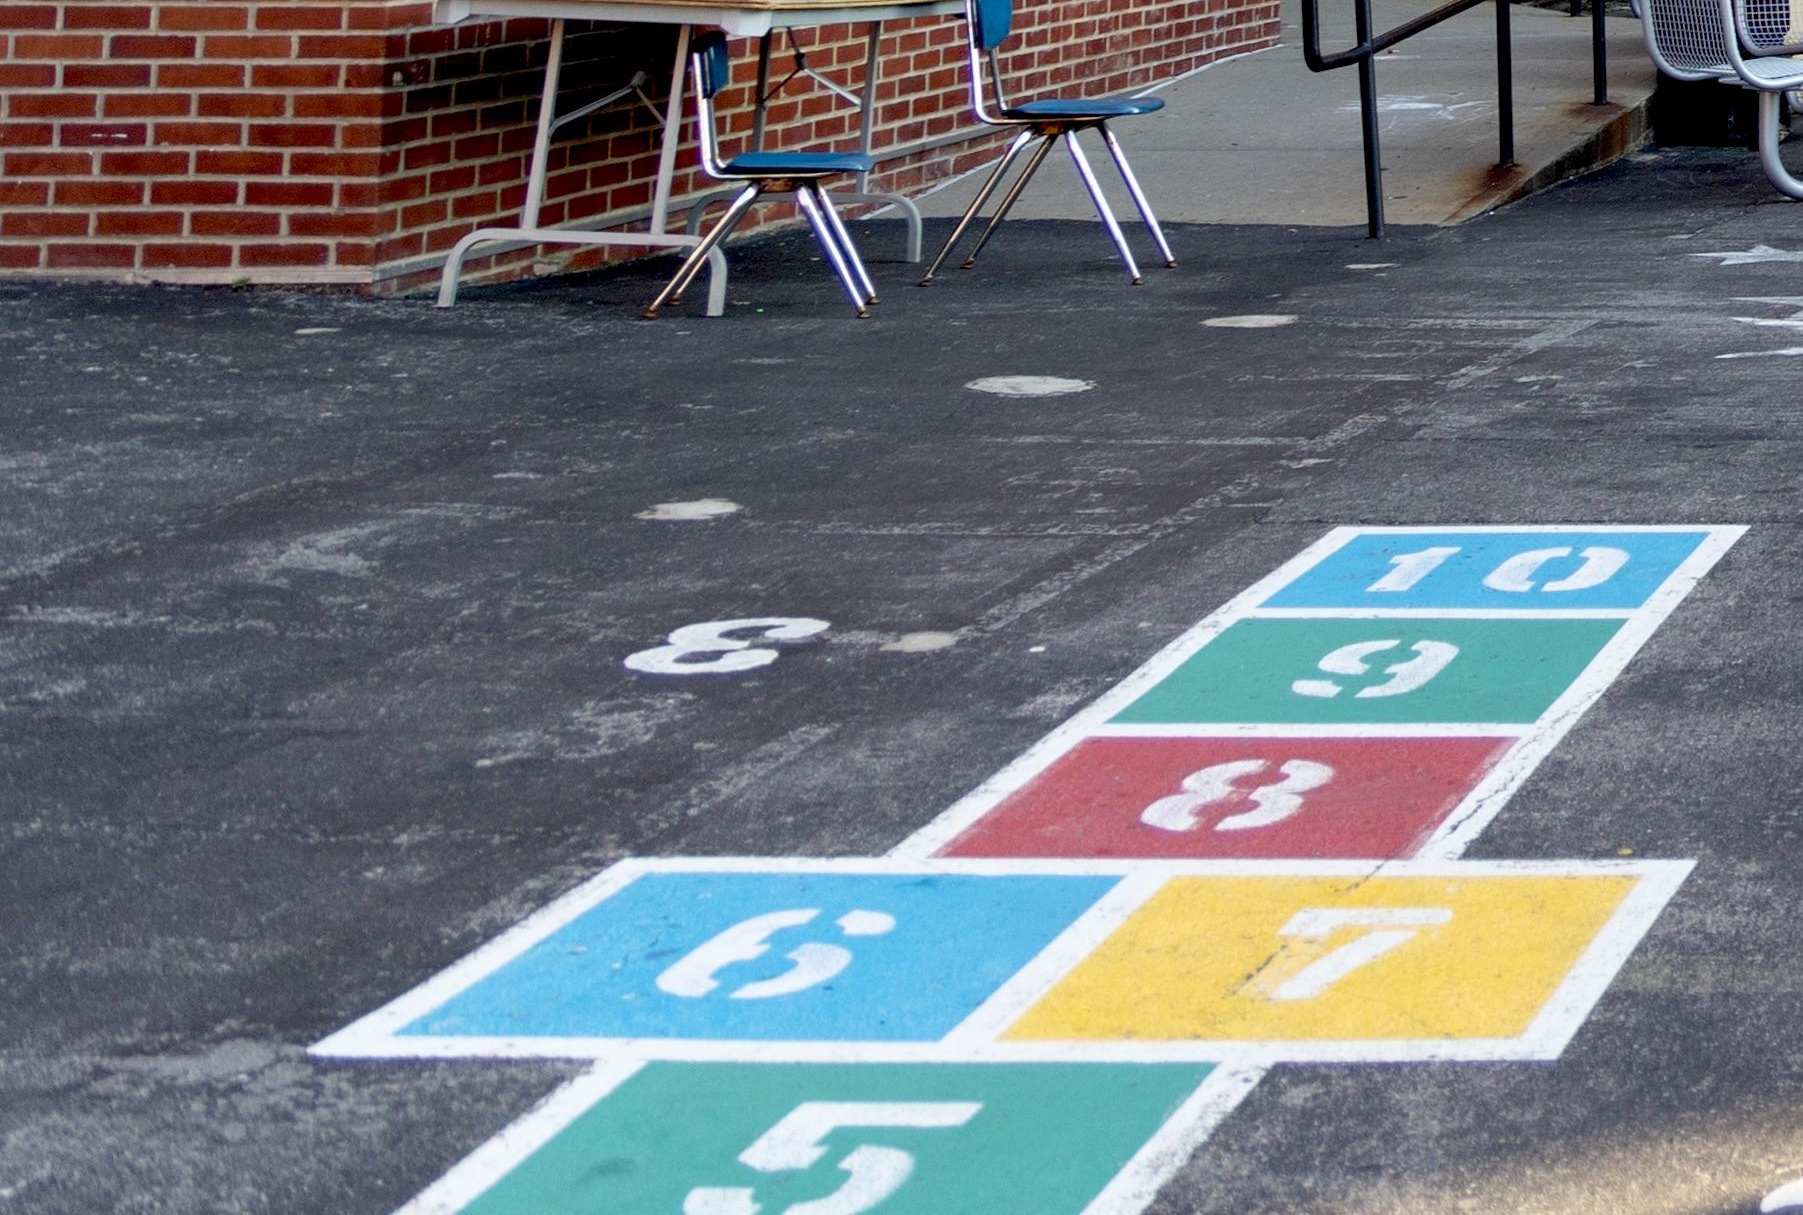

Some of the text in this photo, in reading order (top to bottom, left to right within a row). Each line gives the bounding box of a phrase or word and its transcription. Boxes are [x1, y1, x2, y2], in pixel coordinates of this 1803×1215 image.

[1365, 544, 1632, 594] 10
[1290, 638, 1460, 698] 9
[1138, 758, 1336, 832] 8
[652, 908, 898, 1000] 6
[1260, 906, 1452, 1001] 7
[683, 1101, 983, 1215] 5
